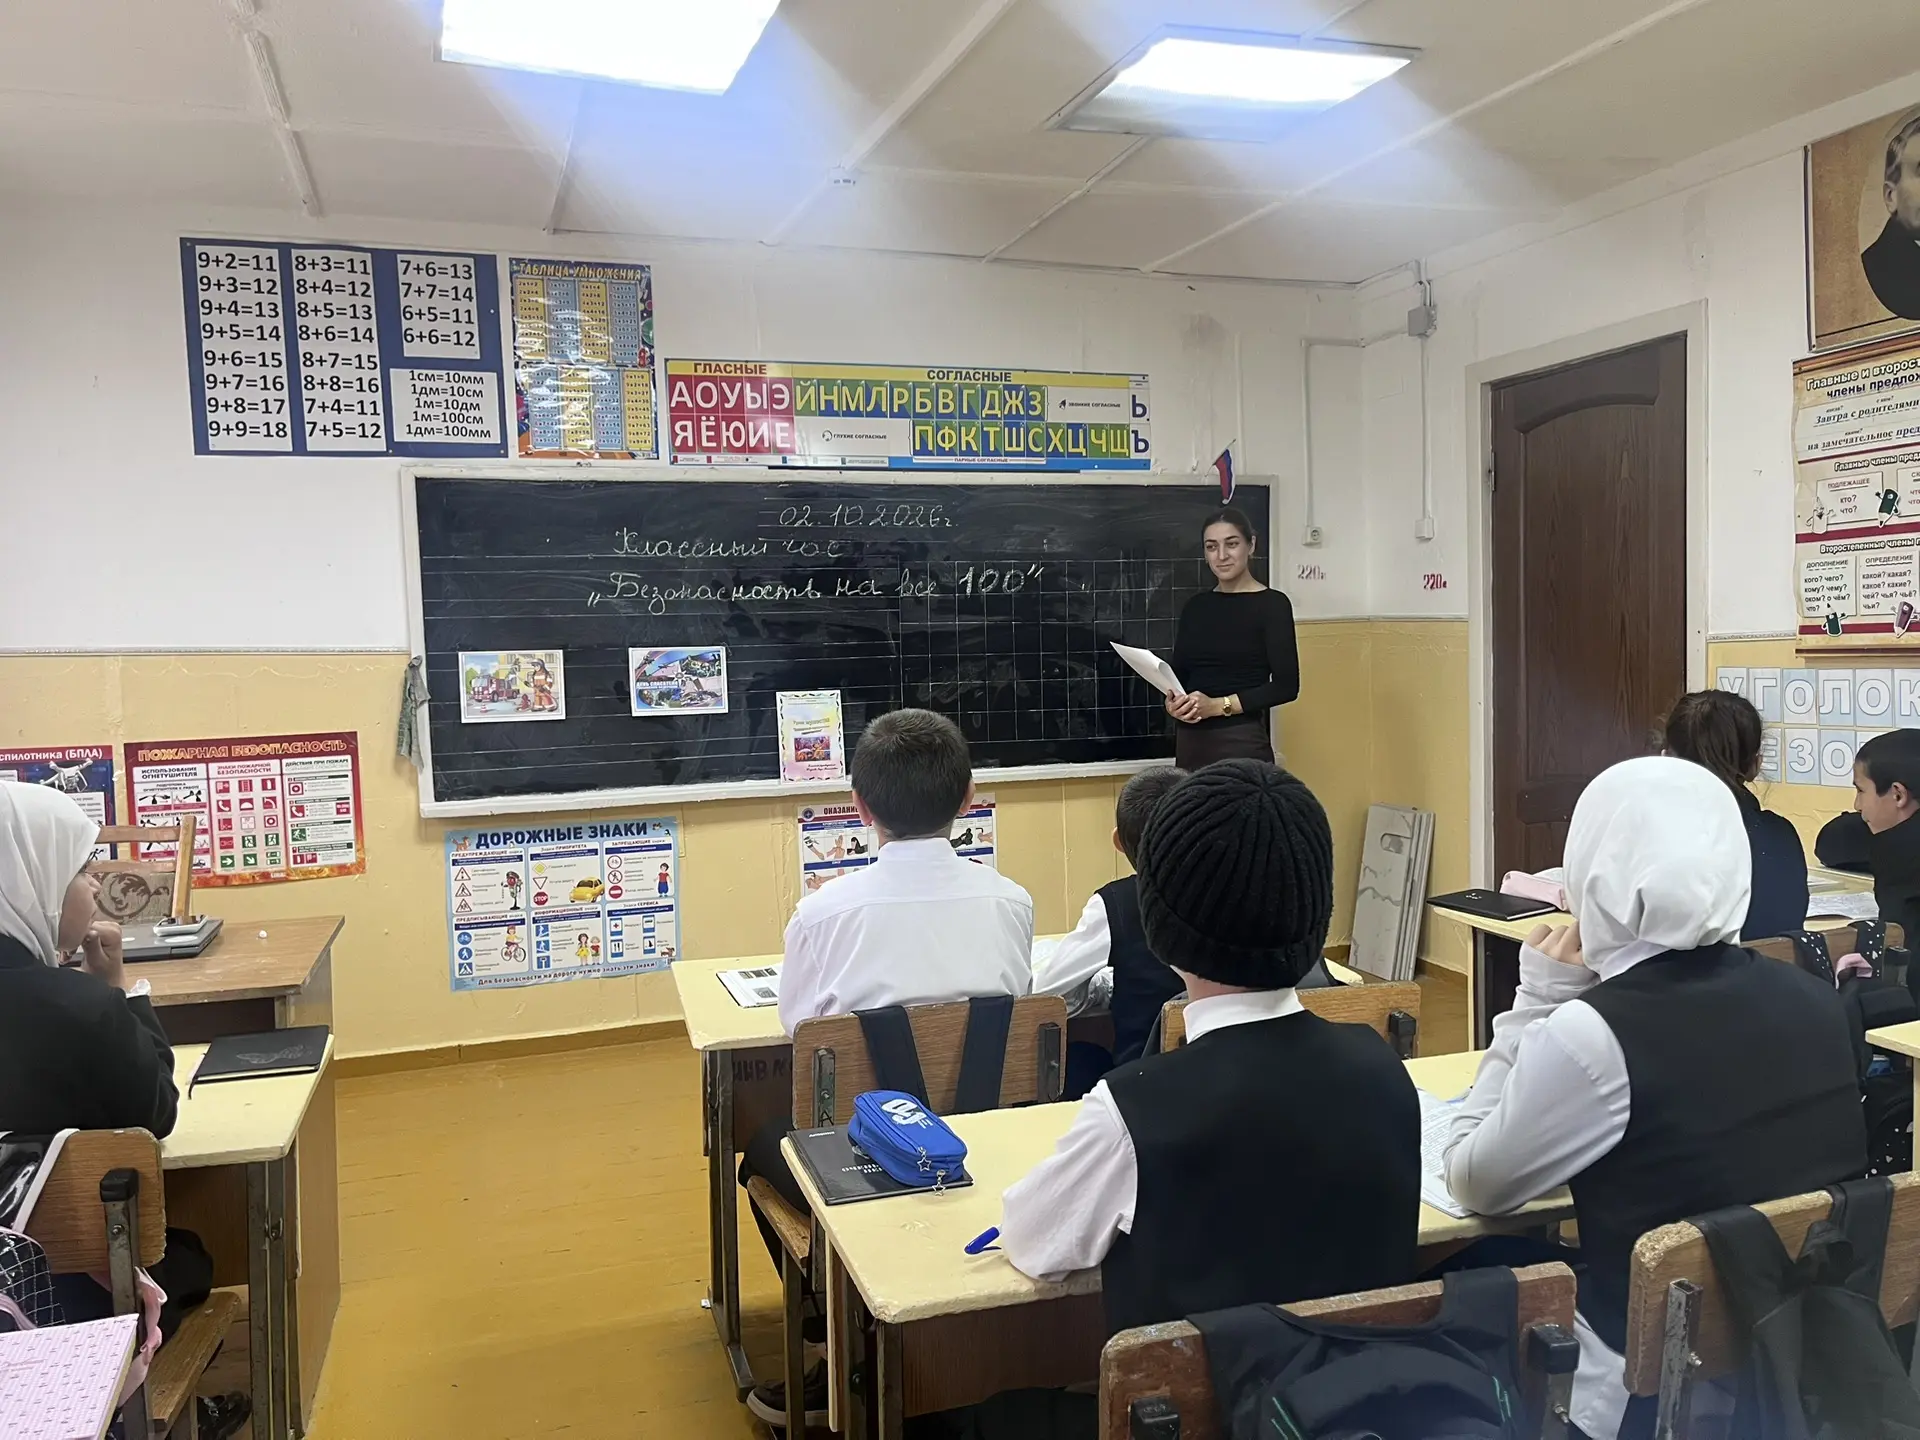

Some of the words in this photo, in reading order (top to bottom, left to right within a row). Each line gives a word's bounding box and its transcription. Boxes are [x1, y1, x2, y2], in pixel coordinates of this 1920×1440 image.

[198, 252, 277, 271] 9+2=11
[295, 256, 371, 275] 8+3=11
[400, 259, 473, 280] 7+6=13
[520, 262, 569, 277] ТАБЛИЦА
[573, 265, 641, 280] УМНОЖЕНИЯ
[199, 276, 278, 295] 9+3=12
[296, 279, 372, 298] 8+4=12
[401, 283, 474, 302] 7+7=14
[200, 299, 280, 319] 9+4=13
[297, 302, 373, 320] 8+5=13
[402, 305, 475, 325] 6+5=11
[202, 322, 281, 341] 9+5=14
[298, 326, 375, 343] 8+6=14
[403, 328, 476, 347] 6+6=12
[204, 350, 283, 368] 9+6=15
[302, 352, 378, 370] 8+7=15
[408, 370, 484, 385] 1см=10мм
[694, 362, 767, 376] ГЛАСНЫЕ
[927, 370, 1012, 383] СОГЛАСНЫЕ
[1806, 370, 1858, 392] Главные
[1861, 367, 1870, 379] и
[206, 373, 285, 391] 9+7=16
[303, 375, 379, 393] 8+8=16
[1827, 382, 1865, 398] члены
[411, 384, 484, 399] 1дм=10см
[207, 397, 286, 414] 9+8=17
[304, 398, 380, 416] 7+4=11
[414, 398, 481, 412] 1м=10дм
[1815, 412, 1848, 424] Завтра
[1857, 399, 1920, 418] родителями
[412, 411, 484, 425] 1м=100см
[209, 420, 288, 438] 9+9=18
[306, 421, 382, 439] 7+5=12
[405, 425, 492, 438] 1дм=100мм
[1807, 442, 1819, 451] на
[1821, 430, 1893, 448] замечательное
[1834, 460, 1869, 472] Главные
[1871, 454, 1897, 466] члены
[1828, 478, 1870, 489] ПОДЛЕЖАЩЕЕ
[1840, 495, 1857, 503] кто?
[1840, 505, 1857, 514] что?
[1820, 540, 1885, 554] Второстепенные
[1887, 538, 1914, 550] члены
[1806, 560, 1849, 568] ДОПОЛНЕНИЕ
[1865, 555, 1913, 564] ОПРЕДЕЛЕНИЕ
[1804, 575, 1823, 584] кого?
[1824, 574, 1844, 583] чего?
[1862, 571, 1886, 579] какой?
[1887, 569, 1911, 578] какая?
[836, 574, 882, 595] на
[1804, 585, 1824, 594] кому?
[1826, 584, 1847, 593] чему?
[1862, 581, 1886, 589] какое?
[1887, 580, 1911, 588] какие?
[1863, 591, 1879, 599] чей?
[1881, 591, 1898, 599] чья?
[1806, 604, 1820, 612] что?
[1863, 601, 1880, 609] чьи?
[65, 748, 103, 759] (БПЛА)
[138, 746, 228, 762] ПОЖАРНАЯ
[231, 740, 347, 757] БЕЗОПАСНОСТЬ
[475, 825, 582, 849] ДОРОЖНЫЕ
[588, 822, 648, 838] ЗНАКИ
[456, 914, 507, 922] ПРЕДПИСЫВАЮЩИЕ
[534, 907, 583, 915] ИНФОРМАЦИОННЫЕ
[495, 974, 543, 983] безопасности
